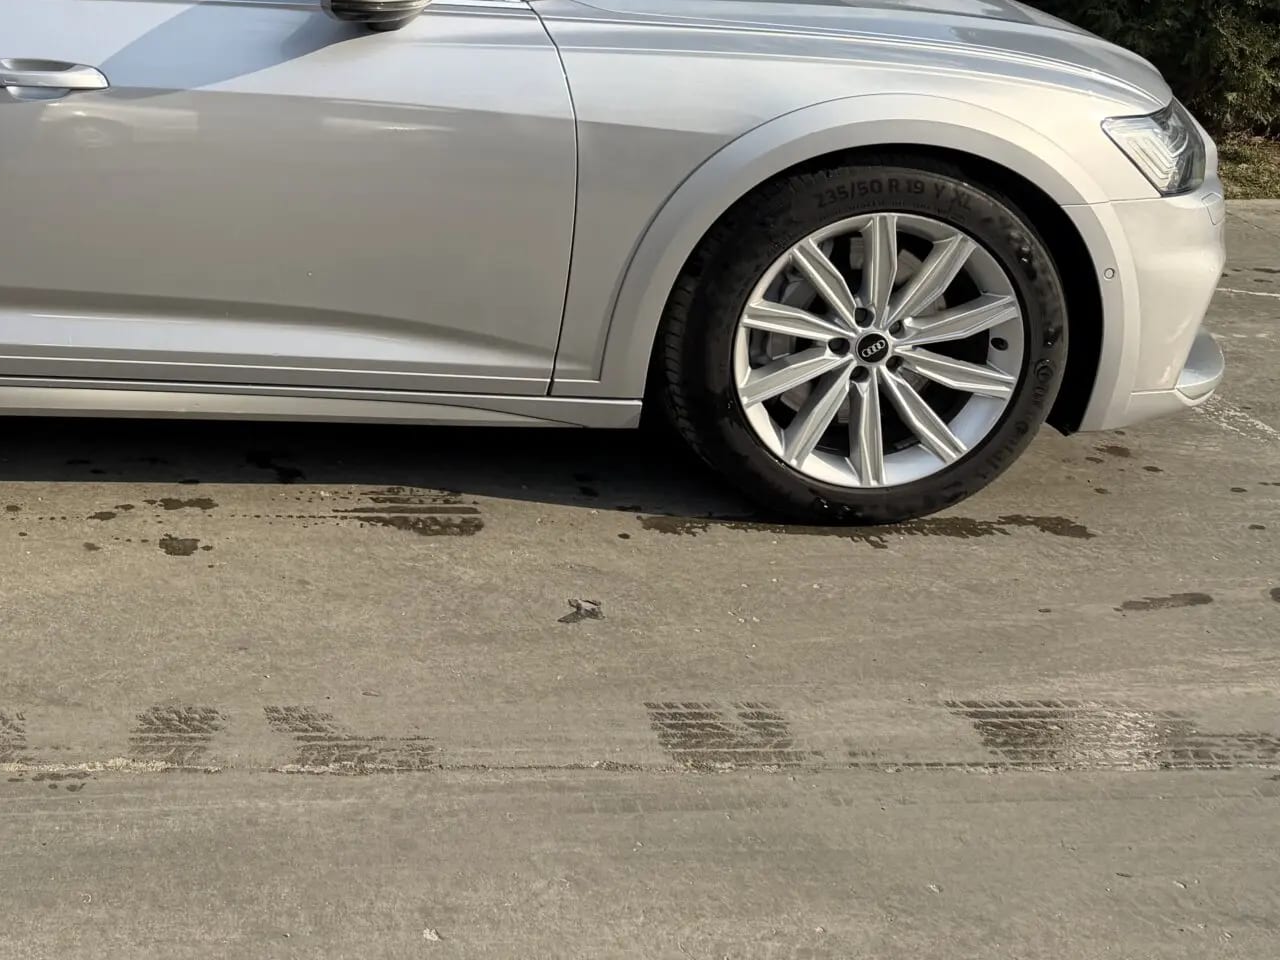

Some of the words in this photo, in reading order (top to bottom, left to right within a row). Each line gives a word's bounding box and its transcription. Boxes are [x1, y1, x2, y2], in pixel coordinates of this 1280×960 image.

[814, 180, 883, 208] 235/50
[887, 178, 900, 192] R
[906, 178, 925, 194] 19
